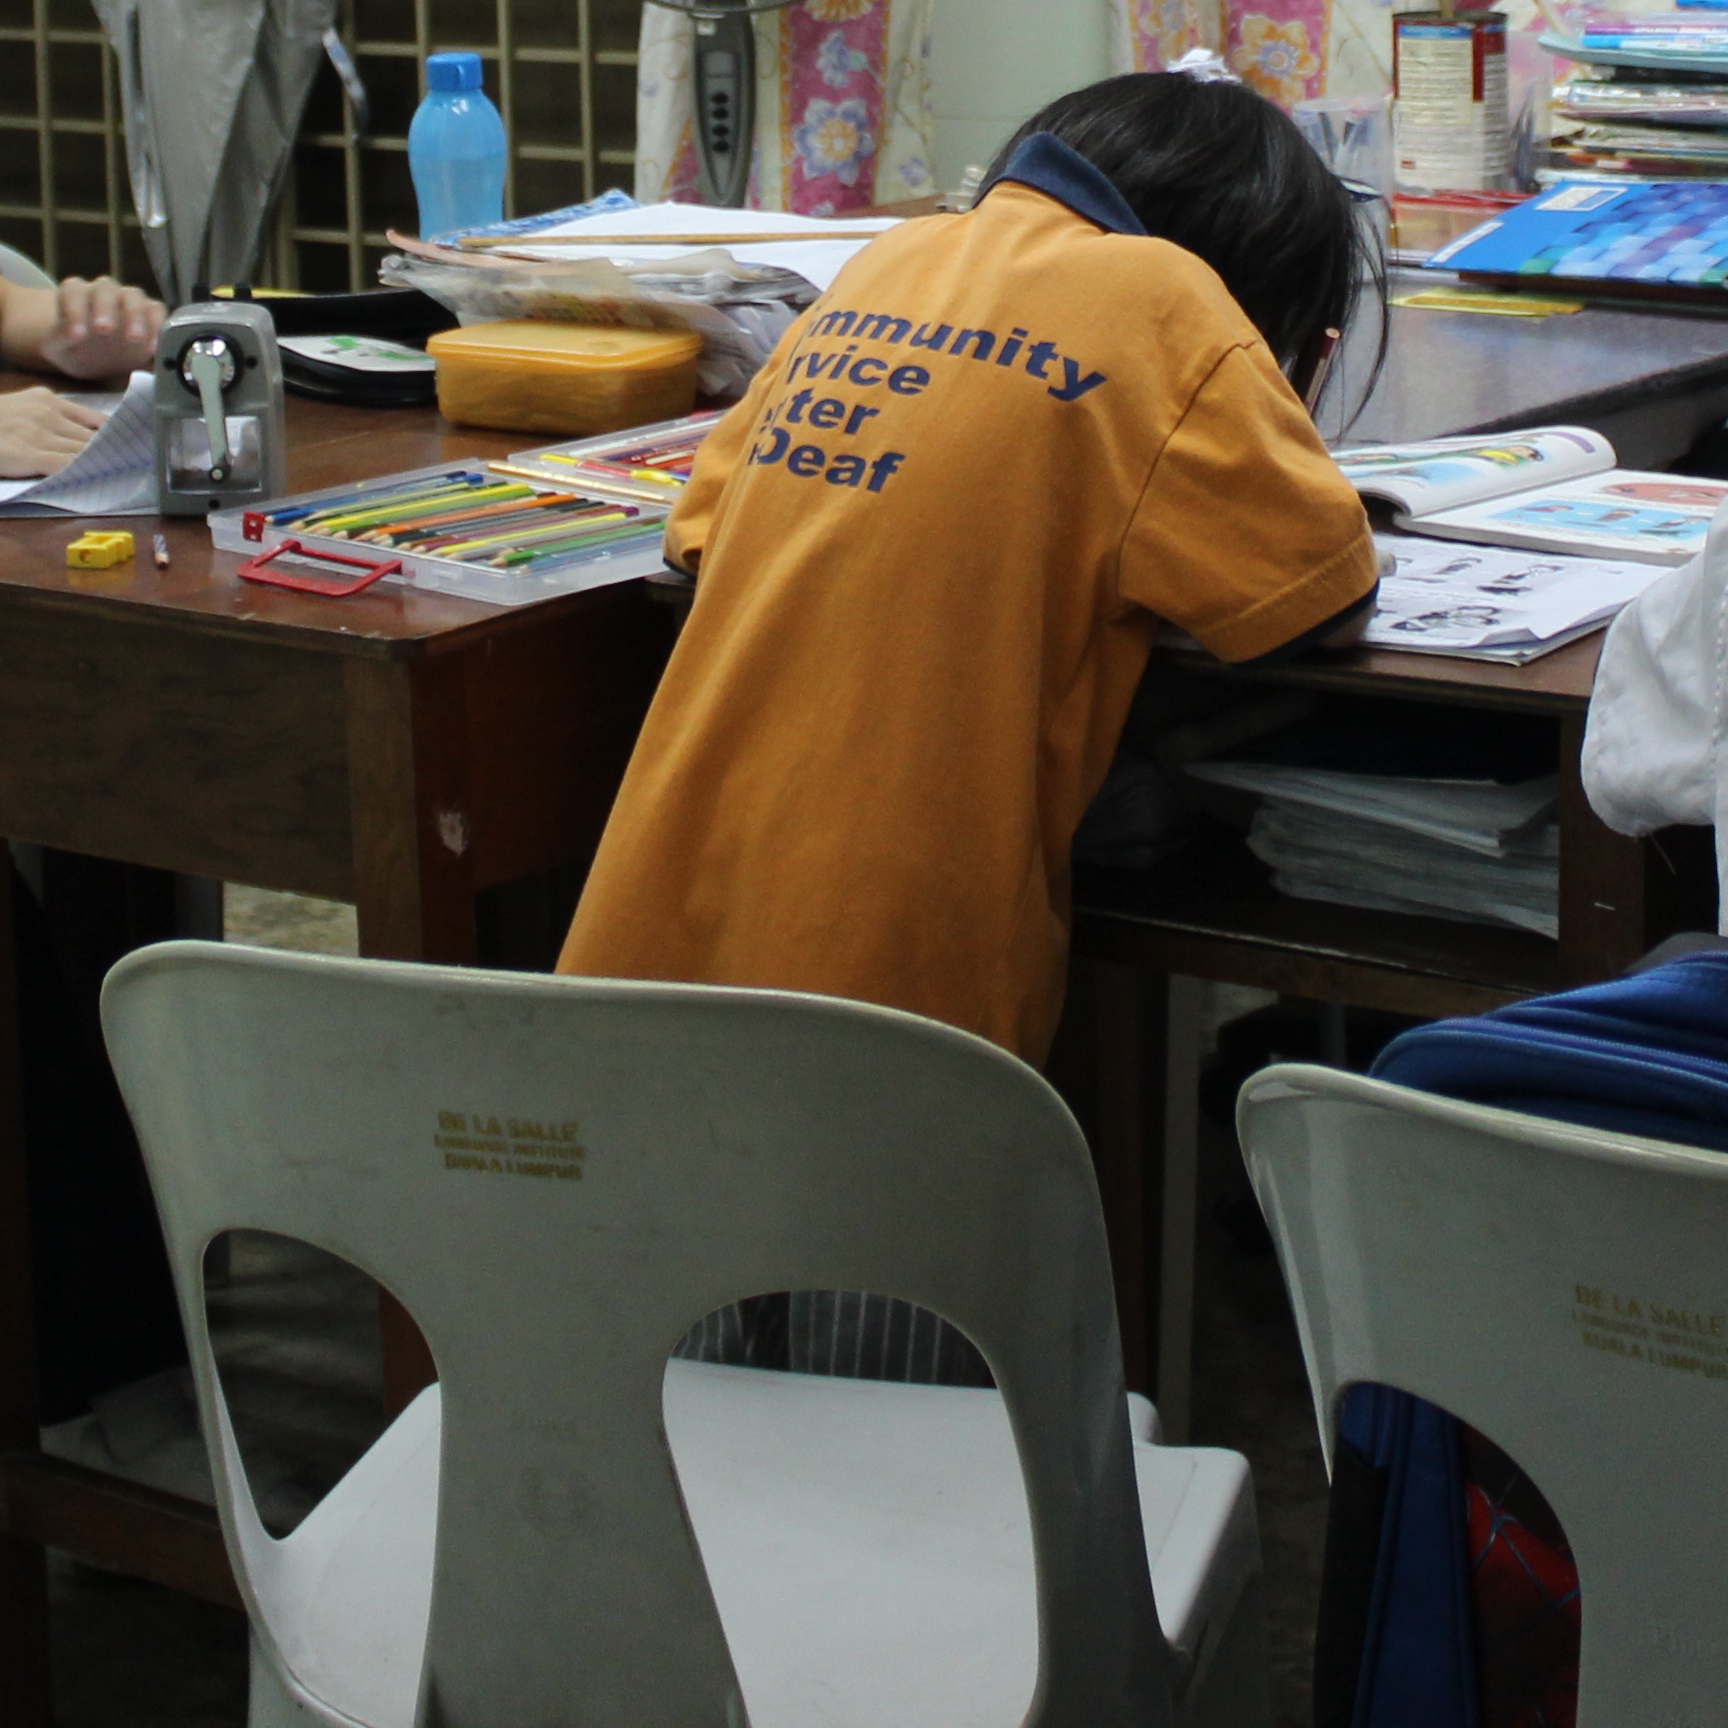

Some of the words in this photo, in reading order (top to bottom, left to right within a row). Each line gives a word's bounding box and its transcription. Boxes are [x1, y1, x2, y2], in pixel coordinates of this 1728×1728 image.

[786, 344, 931, 396] rvice
[808, 309, 1107, 402] mmunity
[766, 388, 881, 436] ter
